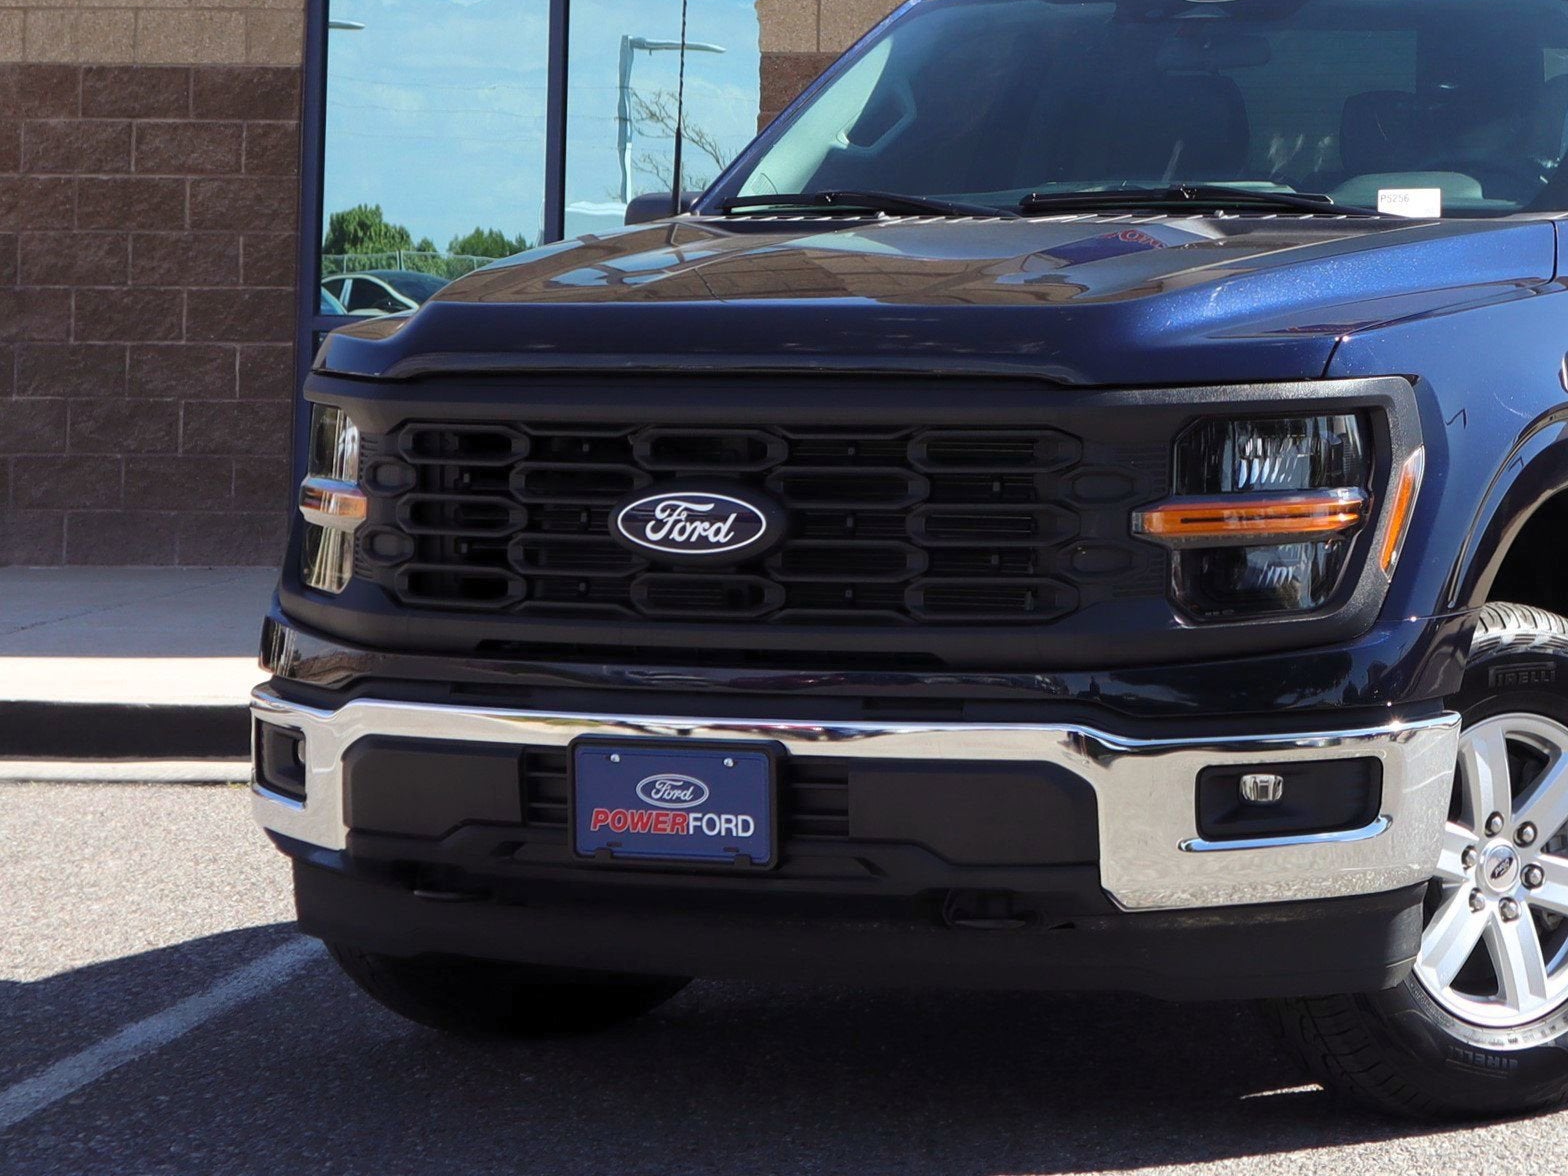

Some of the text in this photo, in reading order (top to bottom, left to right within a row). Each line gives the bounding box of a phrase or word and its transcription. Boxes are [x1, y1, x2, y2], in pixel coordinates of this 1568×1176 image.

[1380, 194, 1410, 203] P5256
[645, 500, 737, 543] Ford
[1488, 661, 1557, 691] PIRELLI
[651, 779, 694, 801] Ford
[590, 808, 755, 837] POWERFORD
